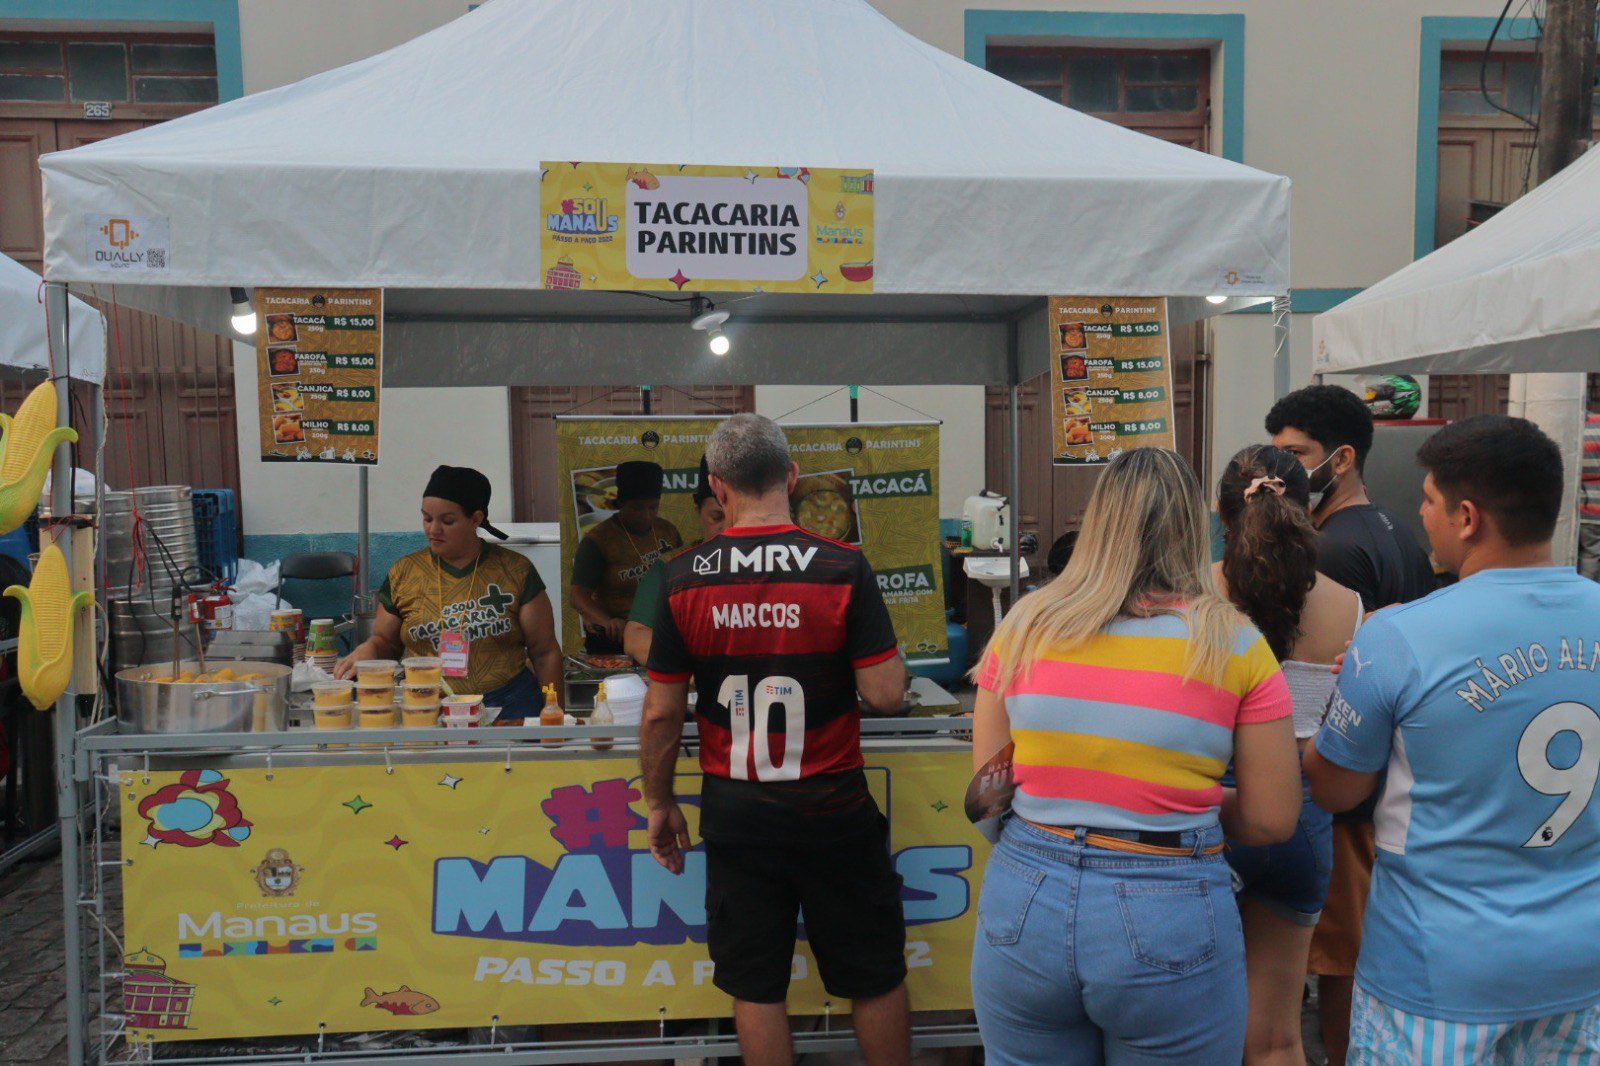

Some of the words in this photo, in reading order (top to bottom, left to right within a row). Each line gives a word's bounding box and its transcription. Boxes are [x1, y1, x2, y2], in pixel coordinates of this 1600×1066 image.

[86, 104, 110, 117] 265
[634, 201, 800, 227] TACACARIA
[547, 212, 619, 234] MANAUS
[552, 234, 573, 243] PASSO
[638, 230, 797, 257] PARINTINS
[265, 297, 310, 306] TACACARIA
[293, 316, 326, 324] TACACÁ
[334, 317, 347, 326] R$
[1083, 324, 1112, 332] TACACÁ
[1120, 325, 1132, 333] R$
[335, 357, 348, 365] R$
[1121, 361, 1134, 369] R$
[298, 385, 334, 393] CANJICA
[336, 389, 348, 398] R$
[1123, 391, 1135, 400] R$
[302, 421, 329, 429] MILHO
[337, 423, 349, 431] R$
[1124, 423, 1137, 432] R$
[578, 436, 639, 445] TACACARIA
[662, 434, 709, 443] PARINTI
[662, 473, 699, 489] ANJ
[848, 472, 928, 495] TACACÁ
[730, 544, 818, 573] MRV
[876, 571, 930, 589] ROFA
[882, 589, 914, 597] AMARÃO
[442, 600, 475, 616] #SOU
[712, 602, 800, 629] MARCOS
[408, 607, 498, 642] TACACARIA
[431, 617, 512, 651] PNTINS
[1456, 641, 1549, 713] MÁRIO
[735, 689, 743, 706] TIM
[774, 686, 792, 695] TIM
[717, 674, 805, 782] 10
[1516, 700, 1600, 849] 9
[432, 844, 971, 938] MANS
[178, 911, 378, 940] Manaus
[473, 955, 625, 986] PASSO
[642, 960, 676, 986] A
